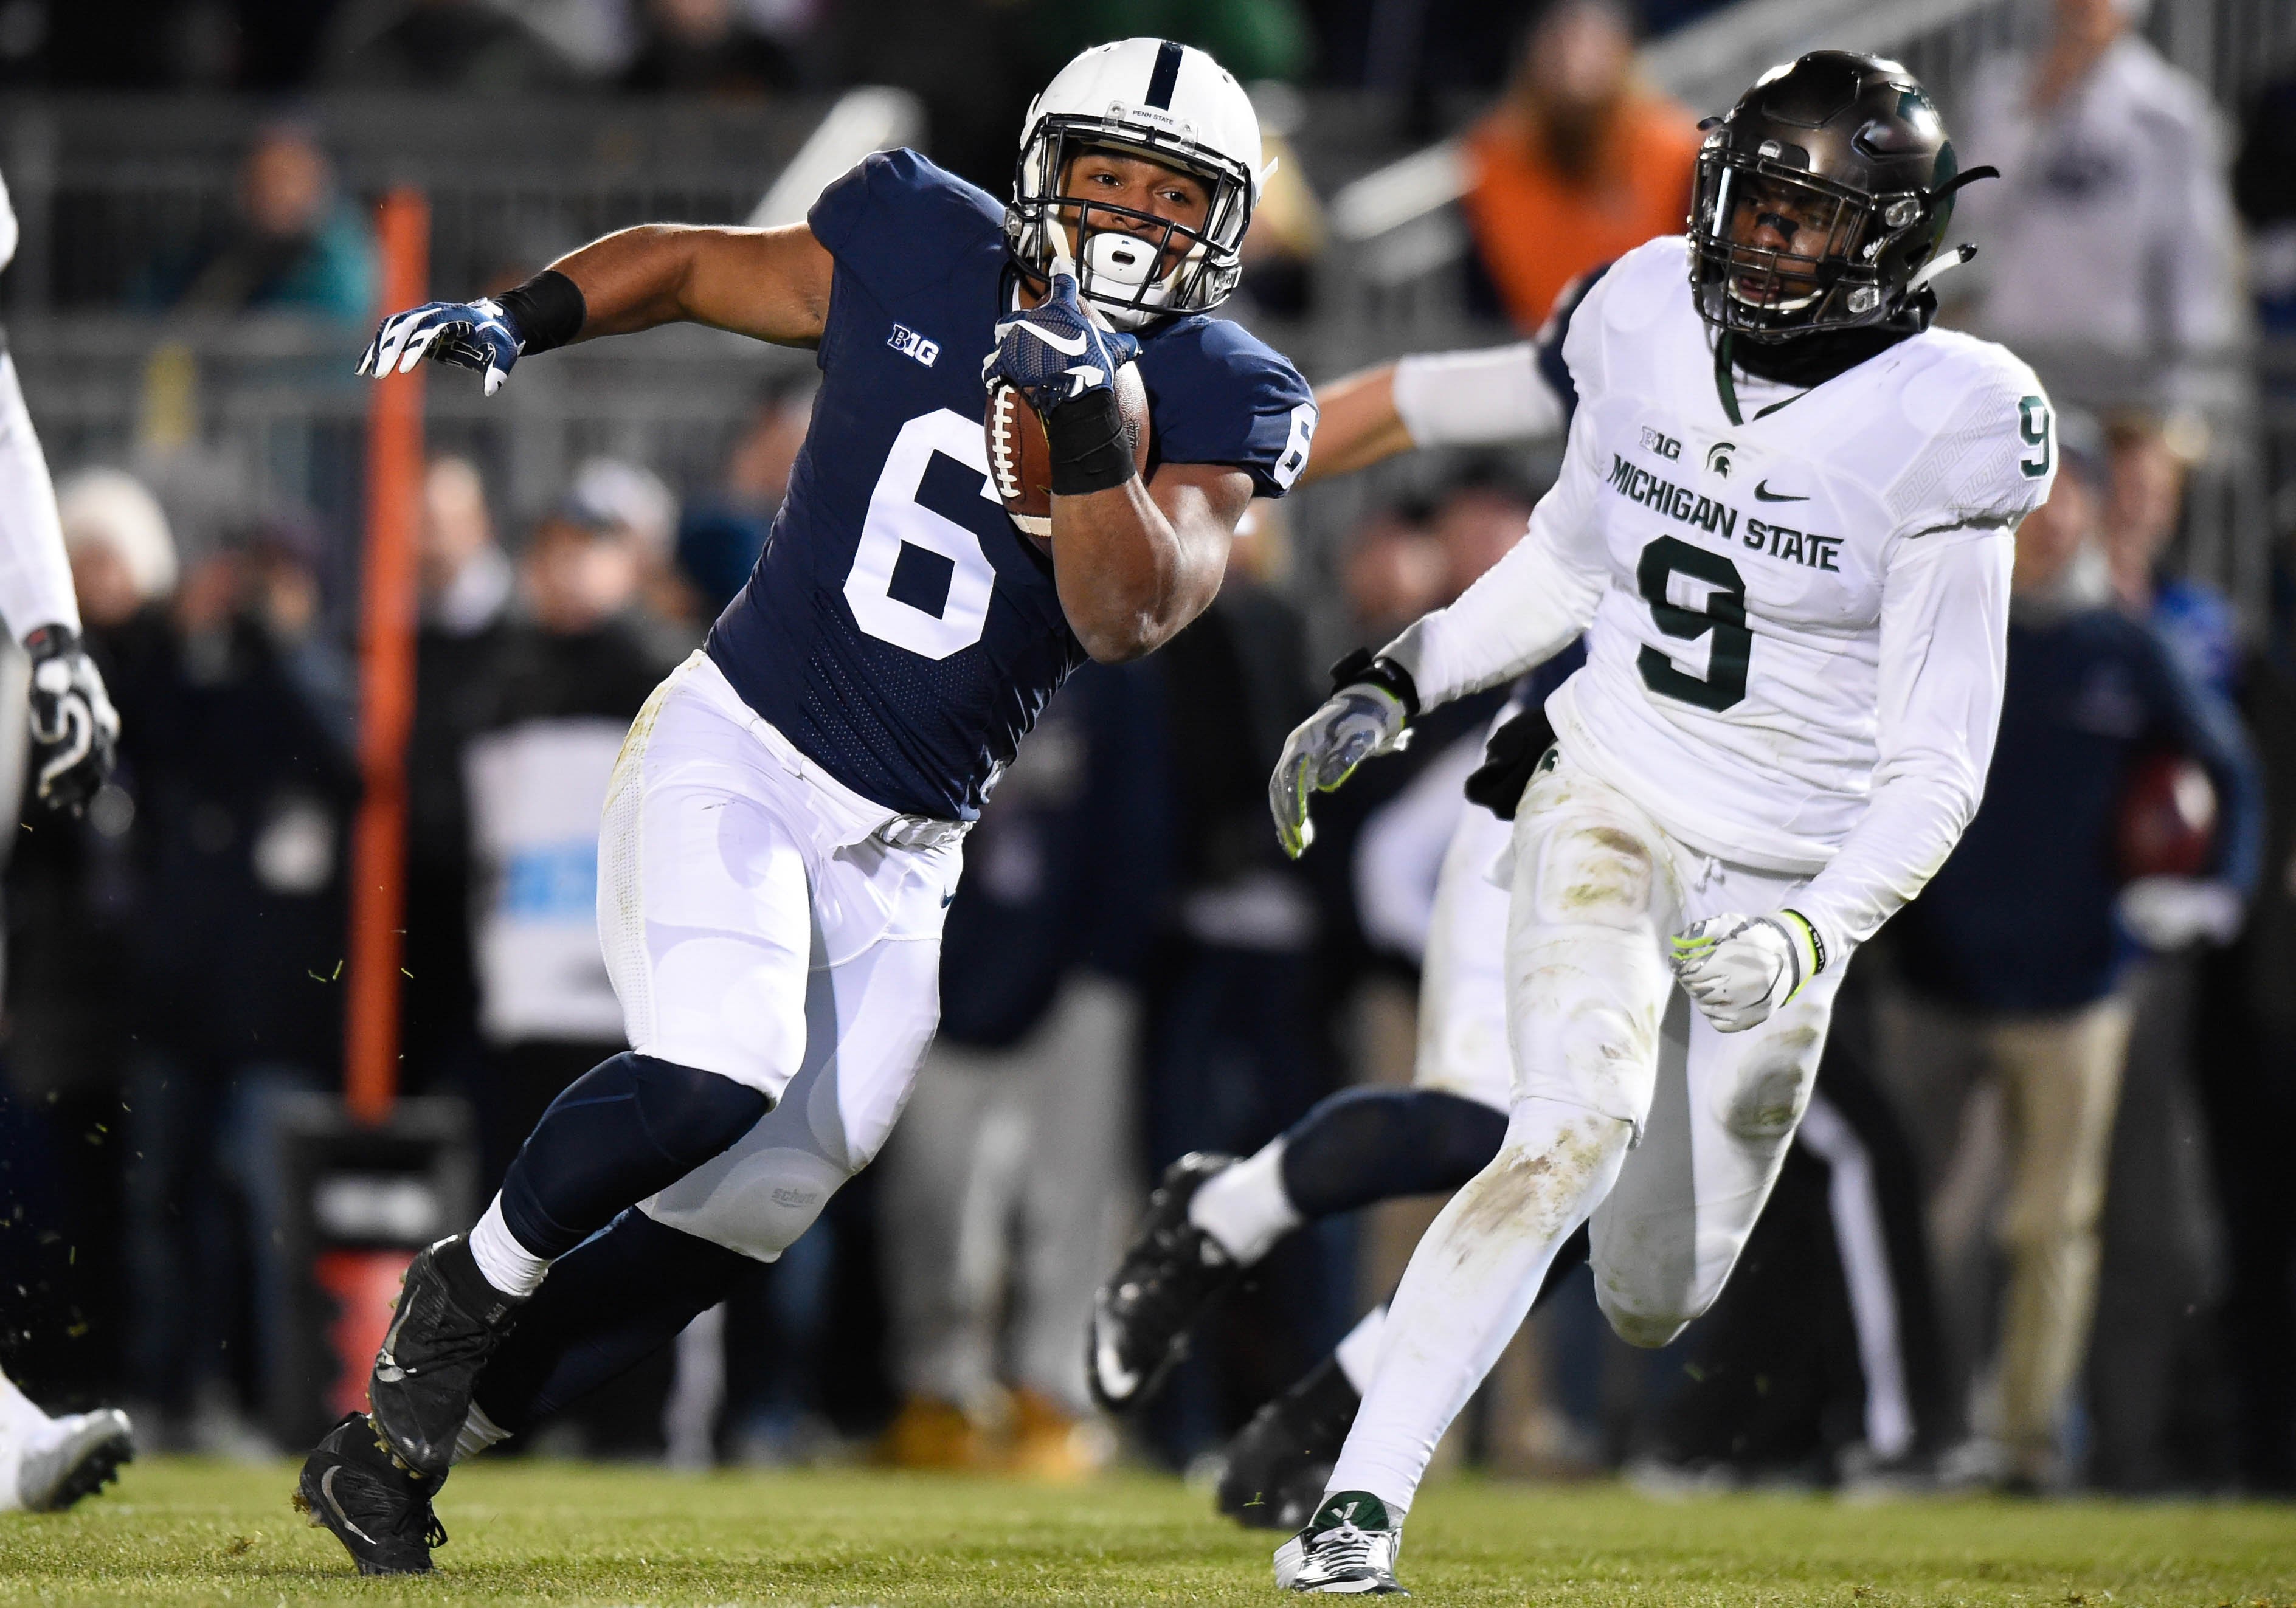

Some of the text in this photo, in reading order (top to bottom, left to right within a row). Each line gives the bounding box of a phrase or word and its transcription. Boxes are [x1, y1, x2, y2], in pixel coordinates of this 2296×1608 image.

[1153, 114, 1174, 125] STATE
[1273, 402, 1318, 490] 6
[2017, 395, 2050, 478] 9
[843, 407, 1003, 661] 6
[1606, 453, 1844, 573] MICHIGAN STATE
[1635, 534, 1752, 713] 9
